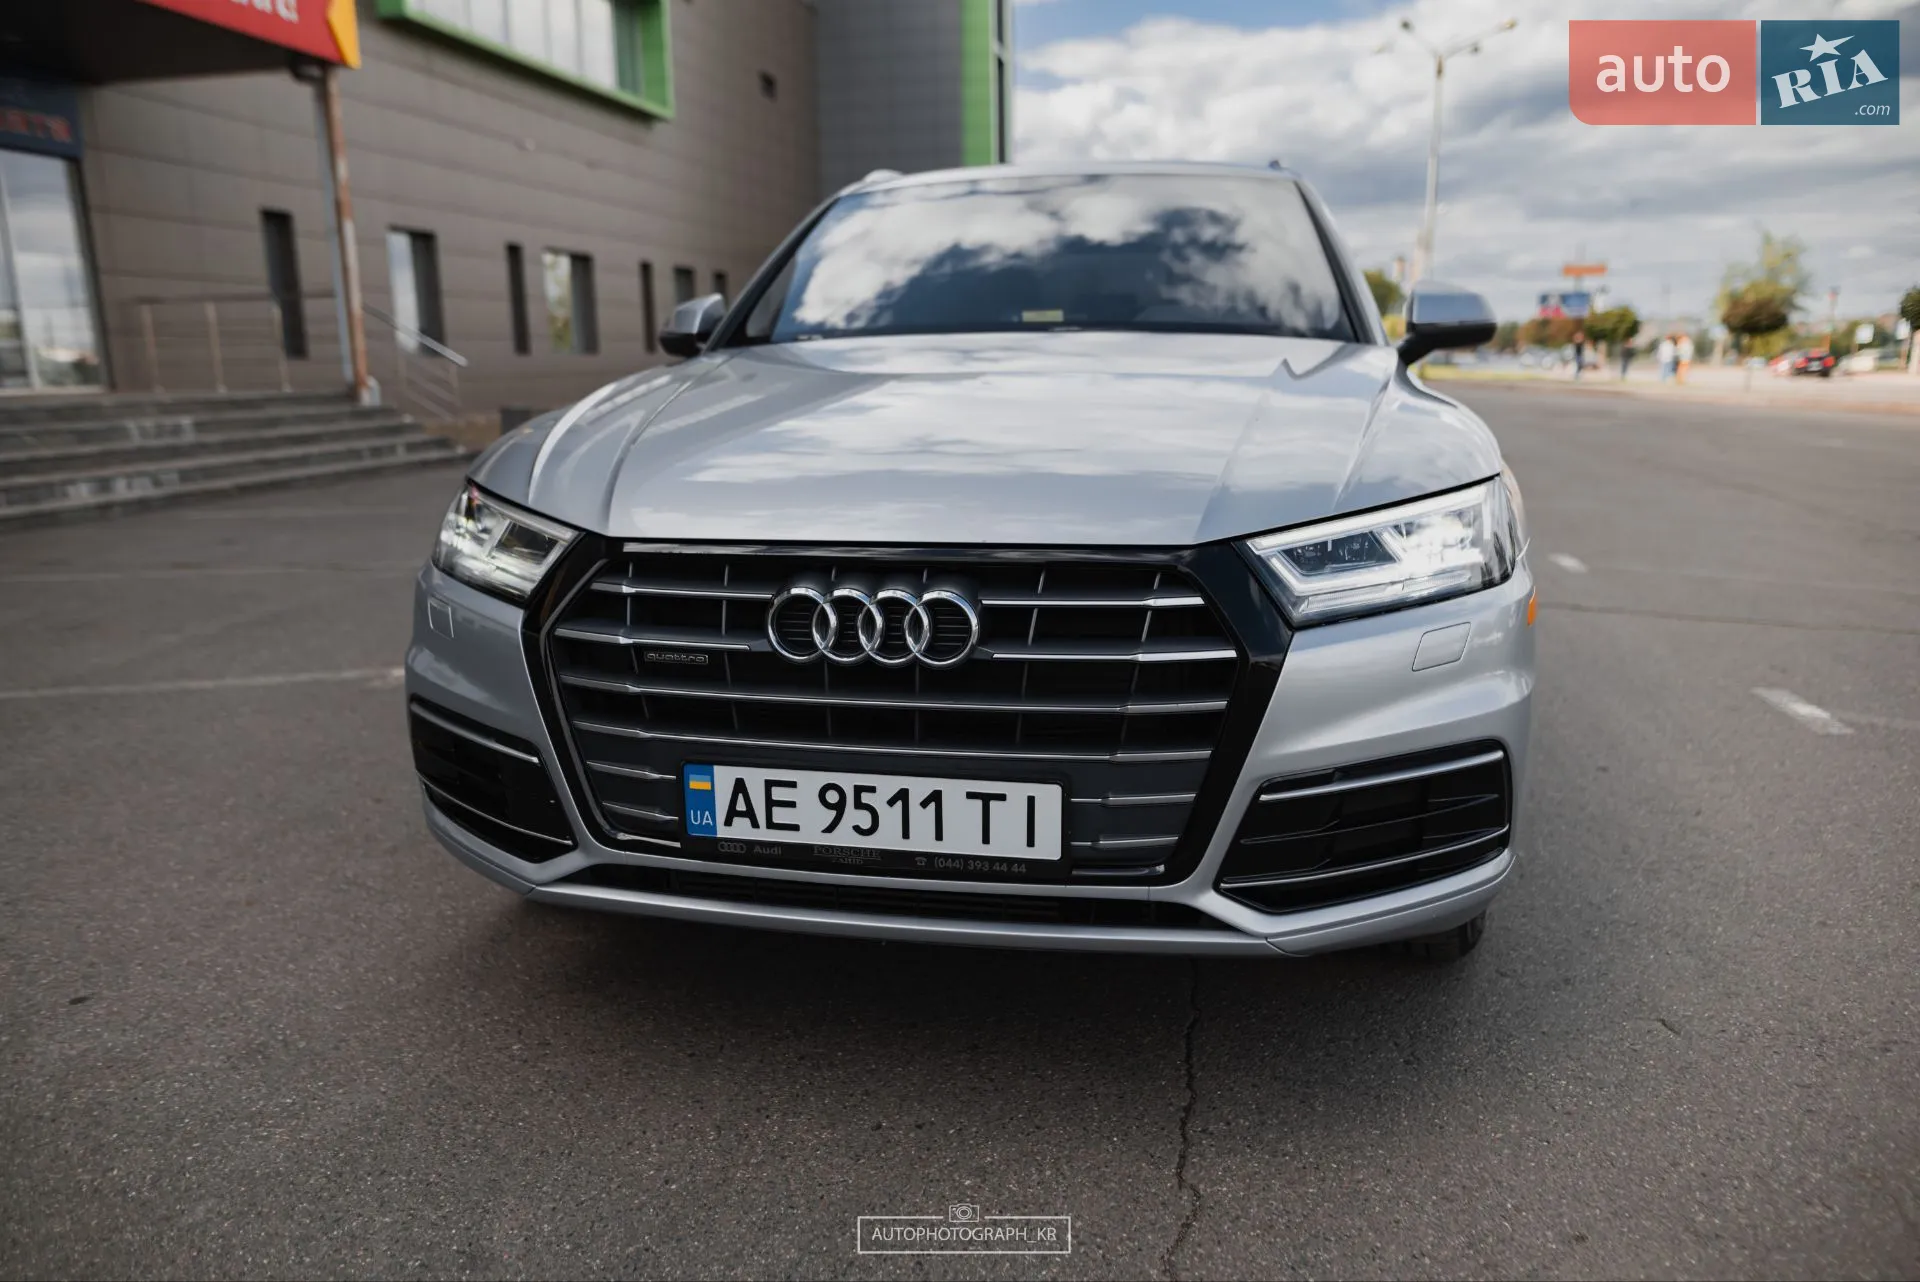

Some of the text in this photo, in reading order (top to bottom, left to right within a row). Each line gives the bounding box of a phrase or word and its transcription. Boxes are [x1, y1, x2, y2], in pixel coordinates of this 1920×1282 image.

[647, 653, 705, 663] quattro
[690, 809, 713, 826] UA
[723, 777, 1036, 848] AE 9511 TI
[753, 845, 782, 856] Audi
[813, 845, 882, 859] PORSCHE
[934, 856, 1027, 874] (044) 393 44 44
